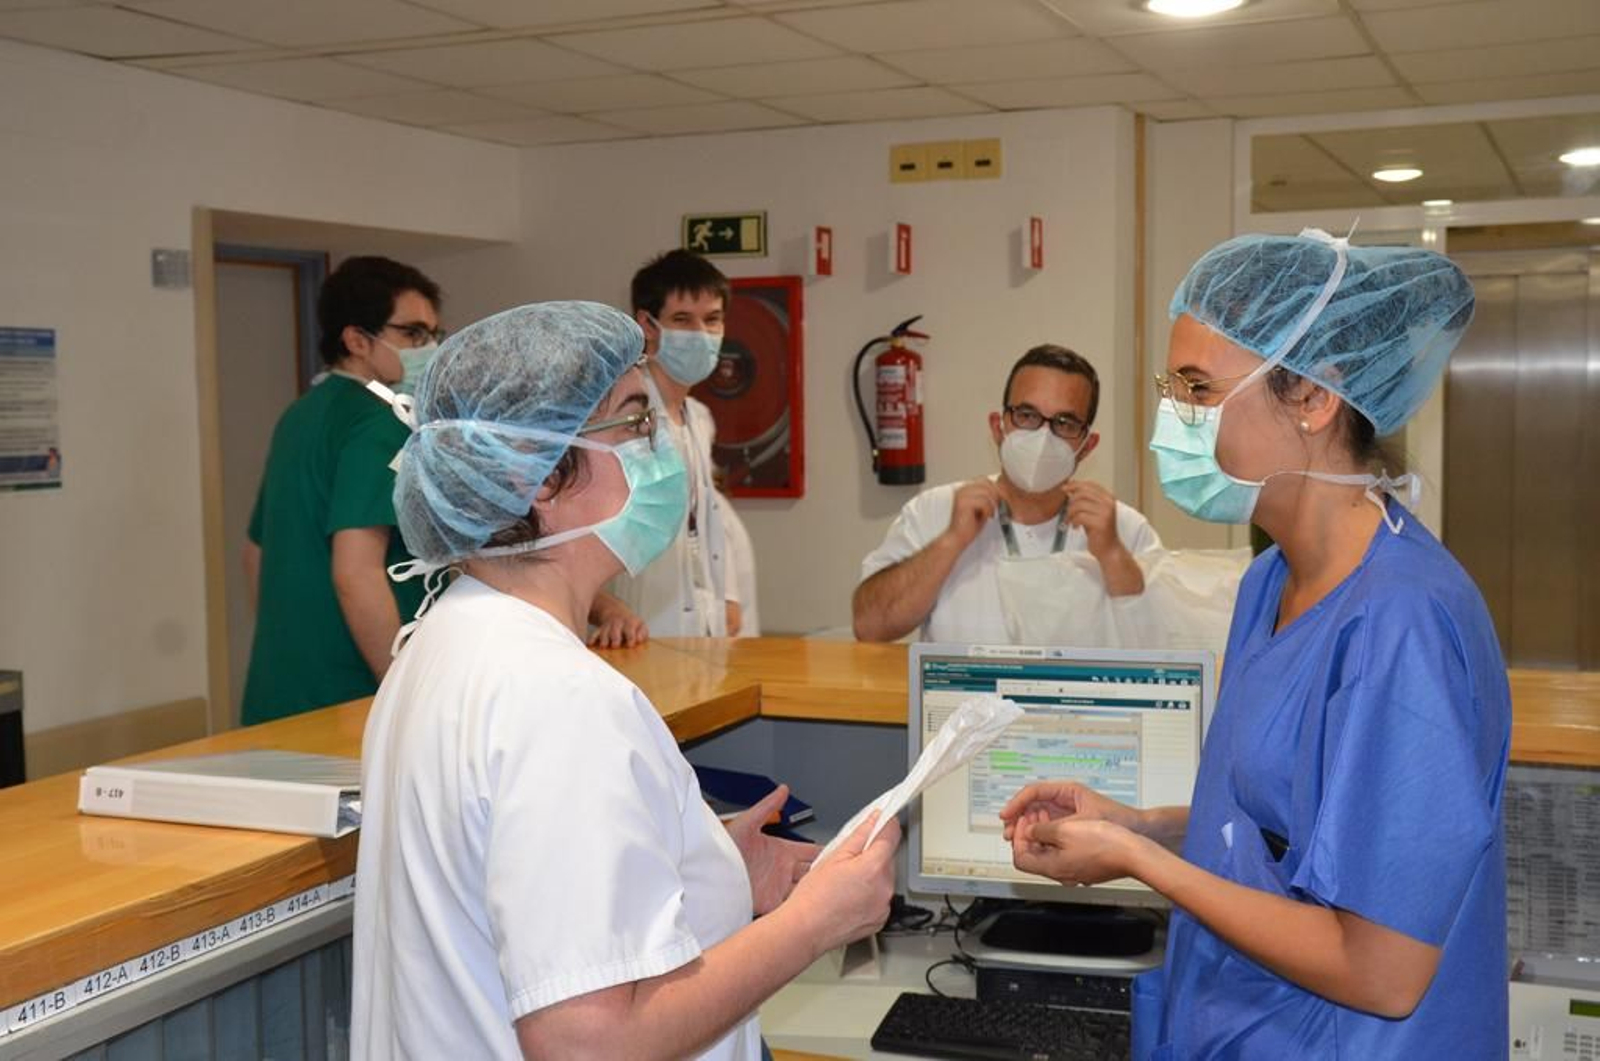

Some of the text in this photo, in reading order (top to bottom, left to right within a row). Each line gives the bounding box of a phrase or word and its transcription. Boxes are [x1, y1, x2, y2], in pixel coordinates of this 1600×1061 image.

[18, 889, 321, 1022] 411-B 412-A 412-B 413-A 413-B 414-A
